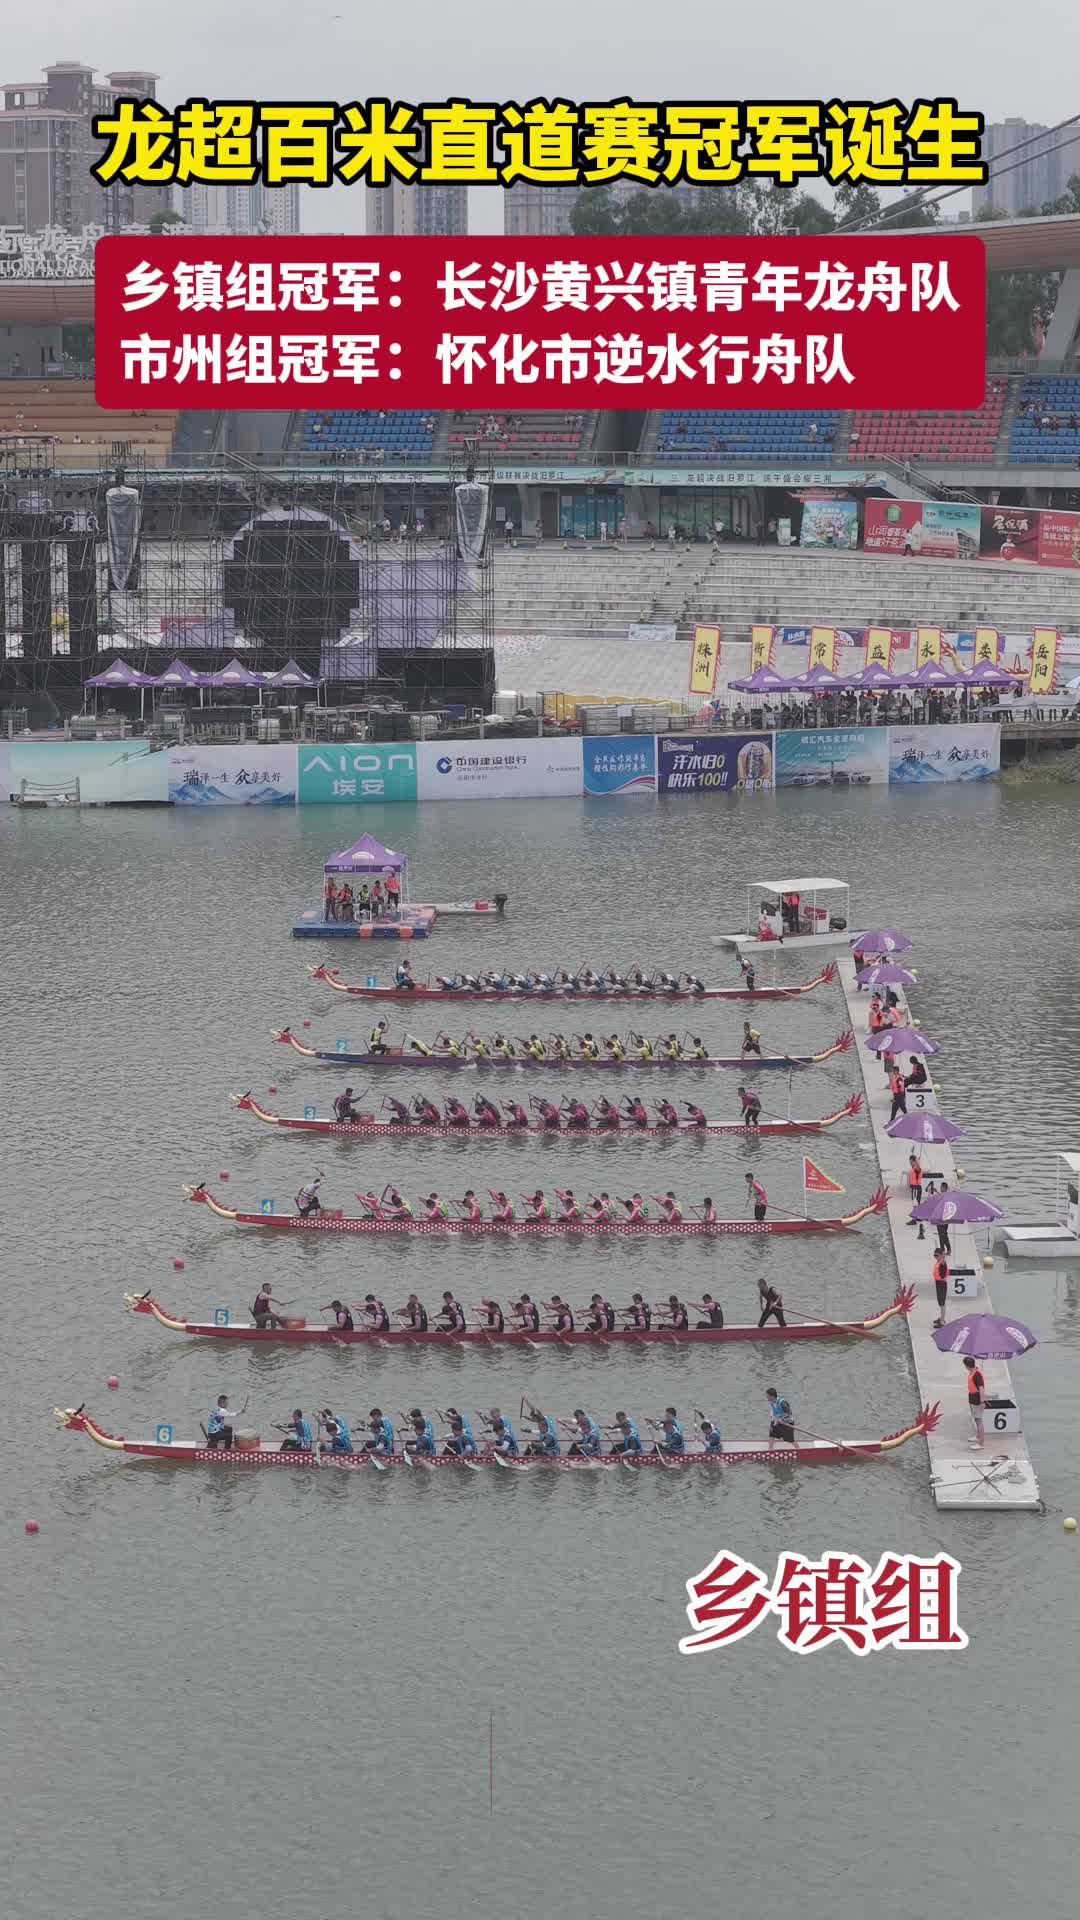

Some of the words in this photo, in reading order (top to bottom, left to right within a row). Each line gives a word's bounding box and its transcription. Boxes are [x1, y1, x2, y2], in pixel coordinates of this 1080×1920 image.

[920, 641, 935, 657] 永
[696, 642, 713, 677] 株洲
[1034, 643, 1049, 678] 岳阳
[303, 755, 414, 773] AION
[456, 756, 527, 768] 中国建设银行
[184, 768, 230, 786] 瑞泽一生
[235, 768, 281, 785] 众享美好
[332, 778, 385, 796] 埃安
[338, 1042, 346, 1051] 2
[915, 1094, 925, 1108] 3
[306, 1108, 314, 1118] 3
[925, 1181, 938, 1194] 4
[263, 1202, 271, 1211] 4
[954, 1278, 966, 1295] 5
[217, 1311, 227, 1323] 5
[994, 1411, 1007, 1430] 6
[159, 1428, 170, 1442] 6
